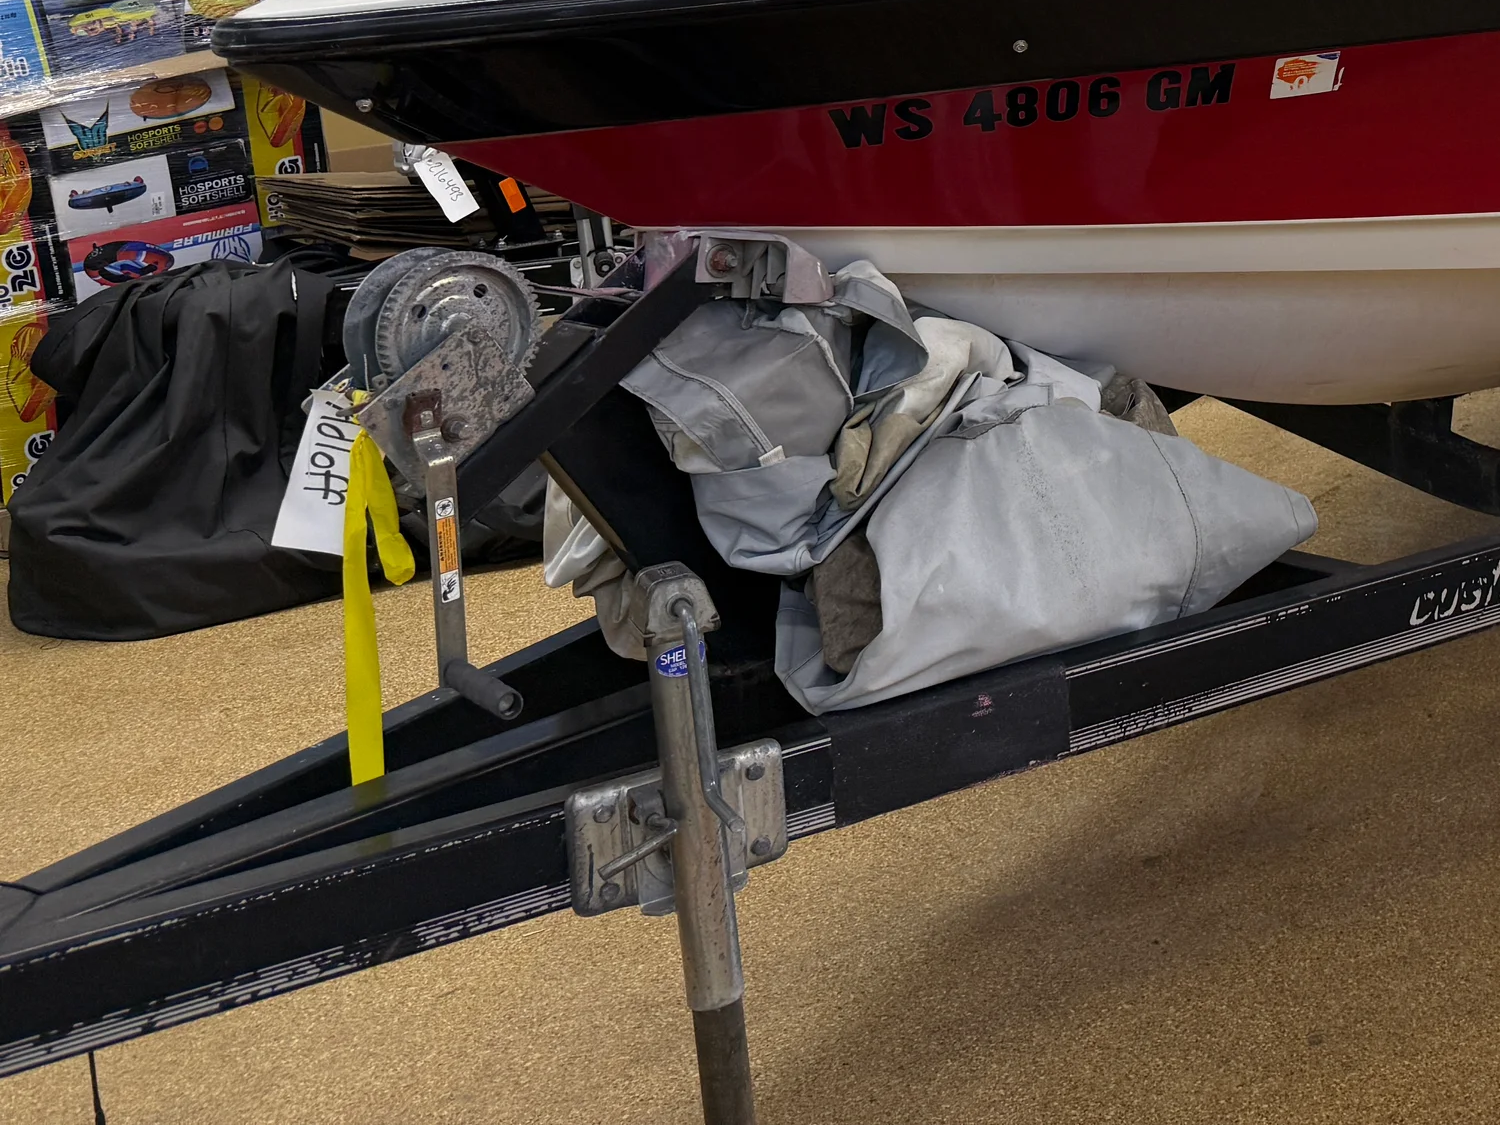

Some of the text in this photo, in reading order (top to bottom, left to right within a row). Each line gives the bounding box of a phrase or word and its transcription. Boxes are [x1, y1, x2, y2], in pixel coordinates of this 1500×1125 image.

[829, 63, 1236, 149] WS 4806 GM
[178, 174, 245, 196] HOSPORTS
[180, 186, 247, 206] SOFTSHELL
[5, 243, 38, 293] 2G
[659, 649, 687, 666] SHEL
